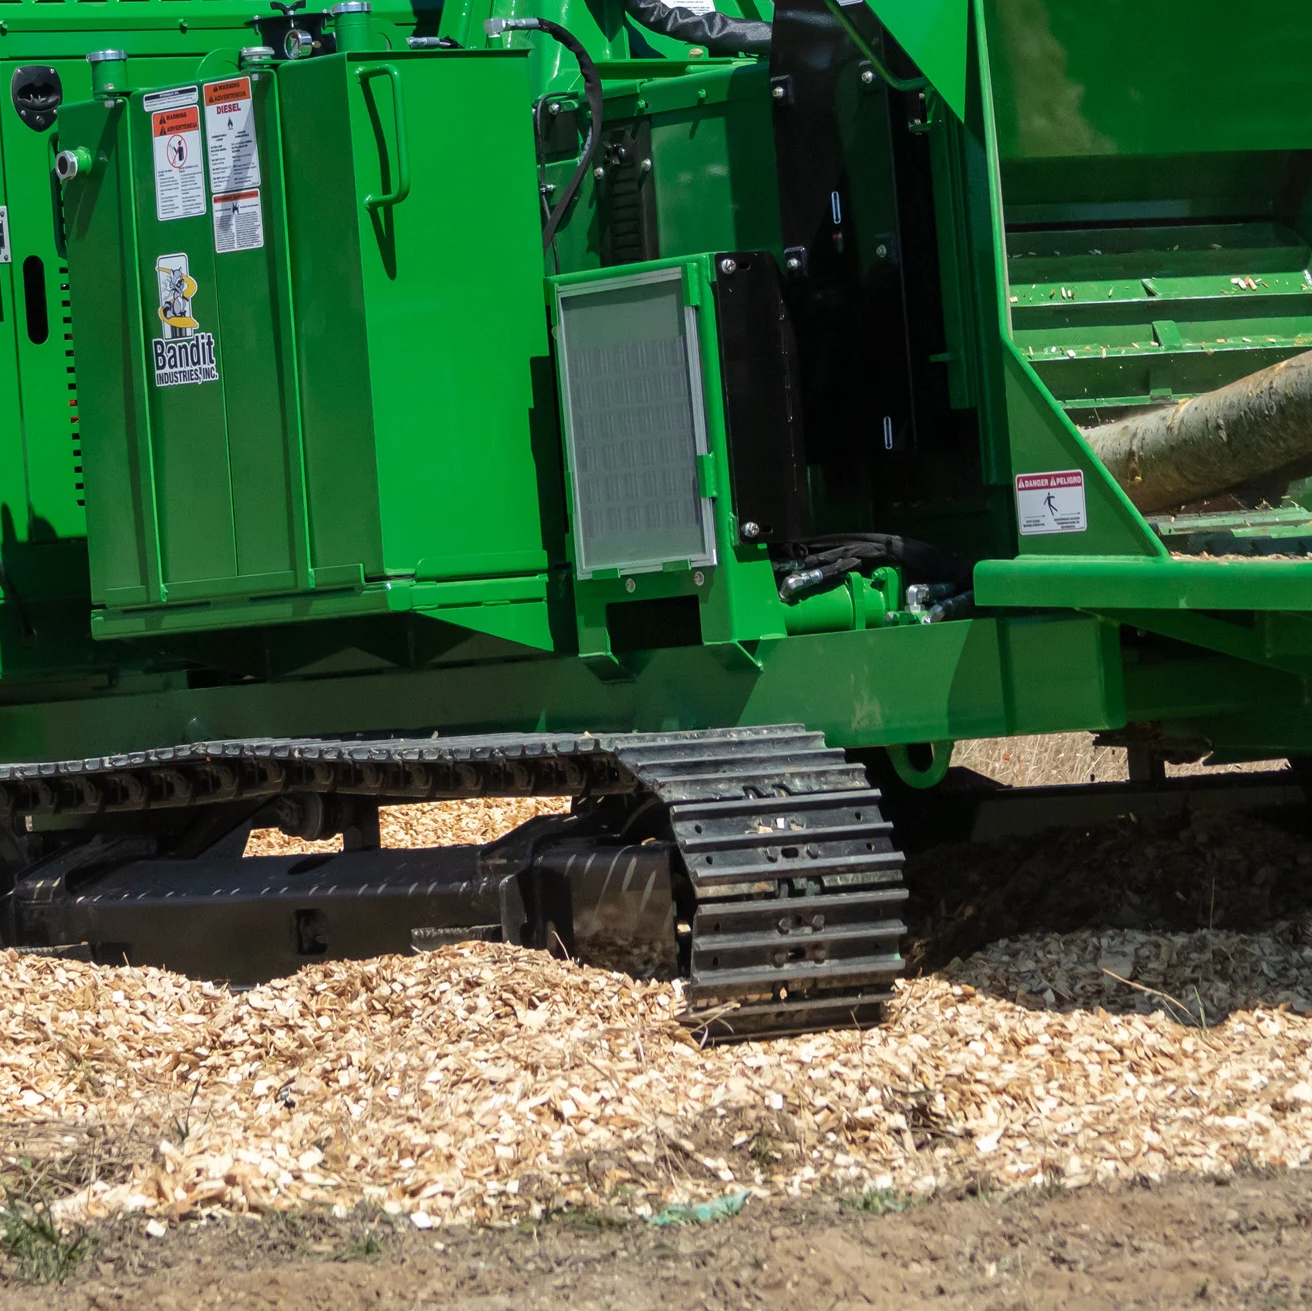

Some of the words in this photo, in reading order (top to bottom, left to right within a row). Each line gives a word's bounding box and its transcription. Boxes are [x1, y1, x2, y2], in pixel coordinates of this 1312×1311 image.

[219, 82, 240, 90] WARNING
[215, 91, 246, 101] ADVERTENCIA
[217, 103, 241, 114] DIESEL
[166, 112, 187, 120] WARNING
[167, 122, 197, 132] ADVERTENCIA
[154, 334, 214, 371] Bandit
[156, 368, 201, 385] INDUSTRIES,
[202, 367, 218, 380] INC.
[1025, 479, 1048, 487] DANGER
[1057, 476, 1081, 485] PELIGRO
